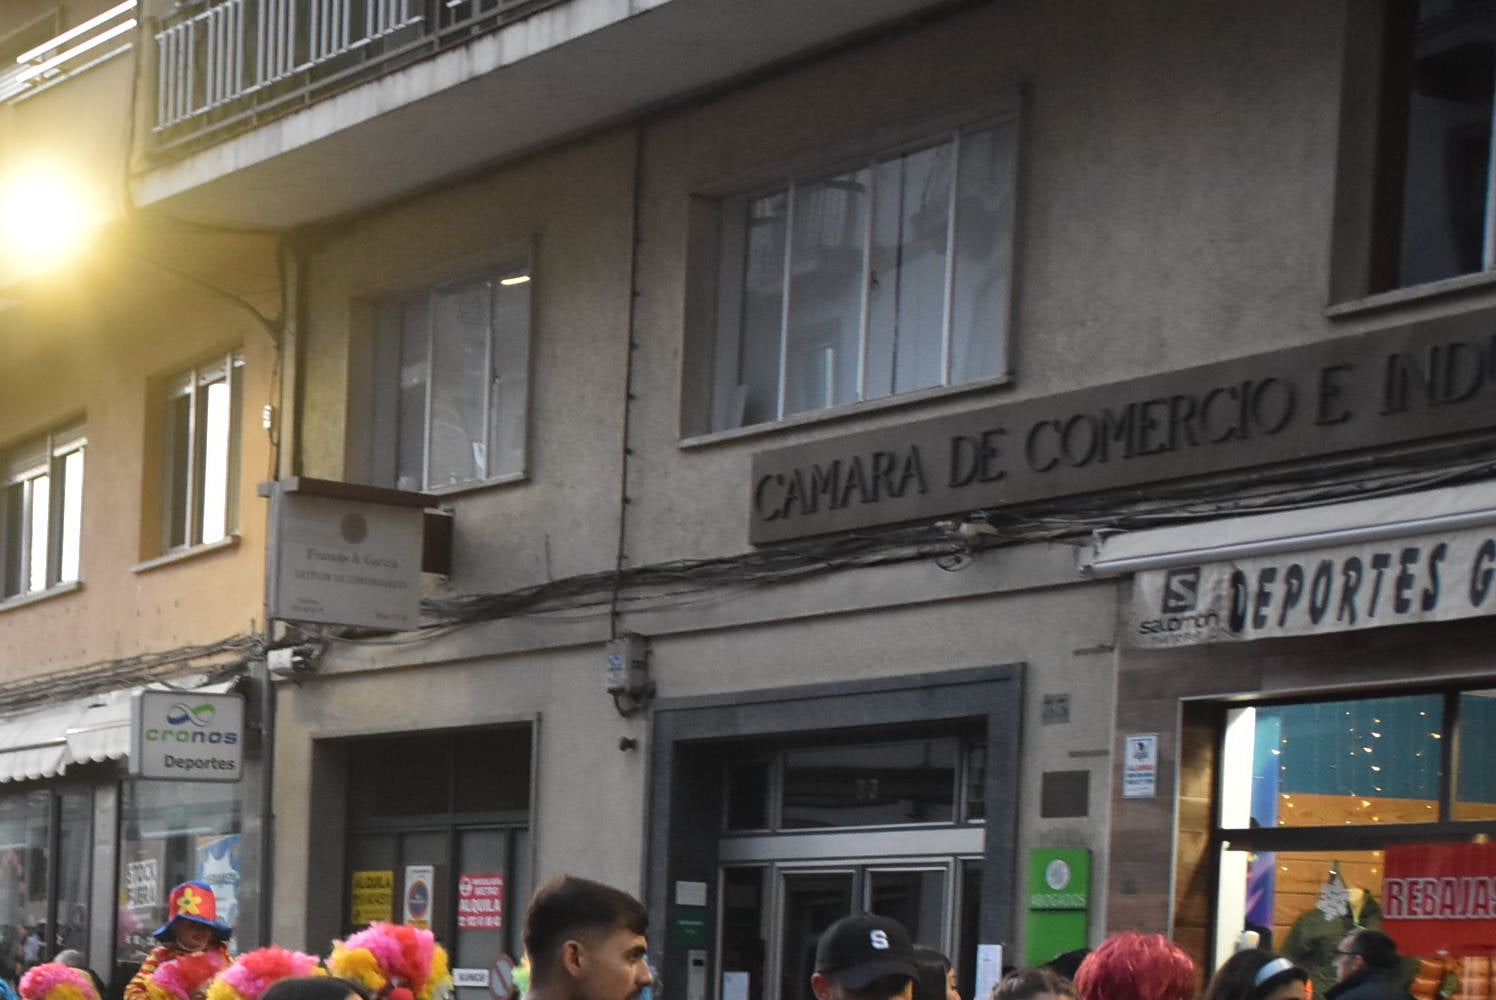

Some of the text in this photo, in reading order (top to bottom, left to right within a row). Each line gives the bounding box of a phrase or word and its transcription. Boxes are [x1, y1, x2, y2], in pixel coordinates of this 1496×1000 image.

[756, 444, 928, 522] CAMARA
[949, 427, 1007, 488] DE
[1025, 377, 1297, 473] COMERCIO
[1315, 362, 1356, 426] E
[1229, 542, 1448, 633] DEPORTES
[146, 729, 238, 745] cronos
[164, 754, 236, 771] Deportes
[458, 898, 502, 912] ALQUILA
[869, 928, 890, 950] S
